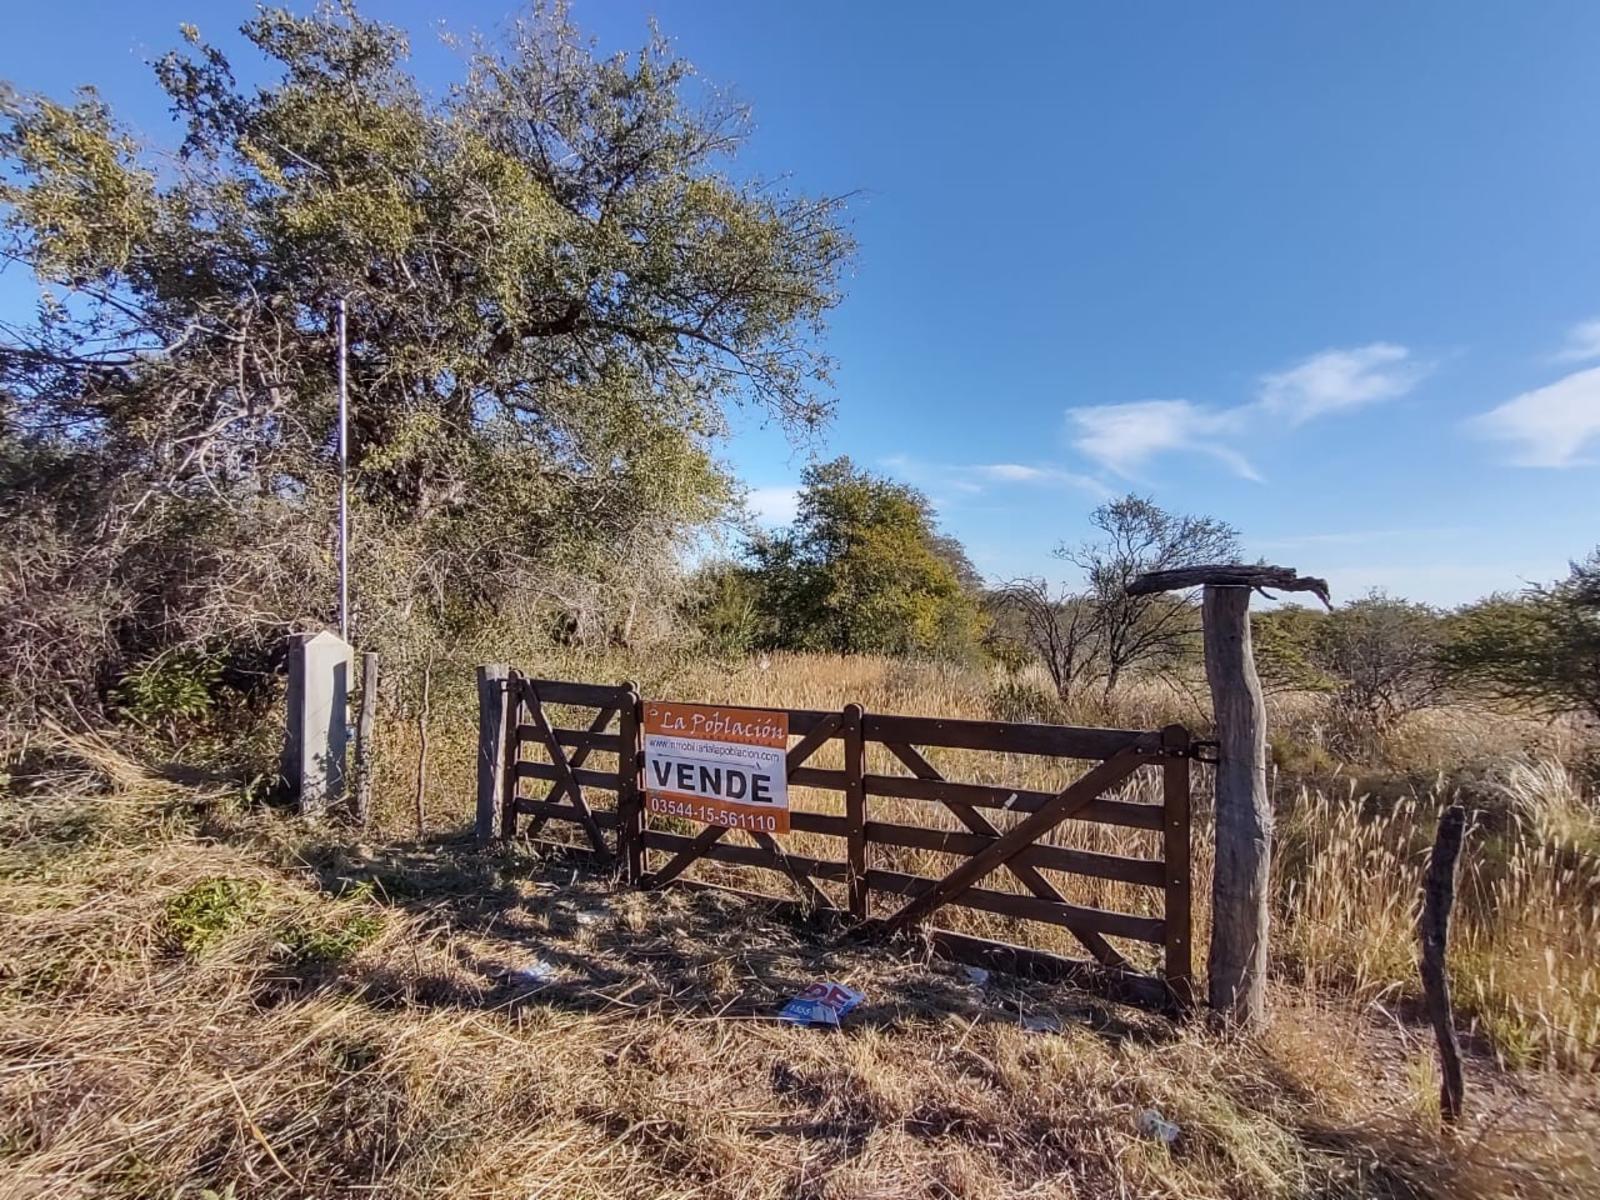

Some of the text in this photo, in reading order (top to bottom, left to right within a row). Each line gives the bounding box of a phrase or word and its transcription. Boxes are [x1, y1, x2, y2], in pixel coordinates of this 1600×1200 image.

[660, 711, 785, 740] La Población
[652, 759, 774, 803] VENDE
[651, 798, 776, 831] 03544-15-561110
